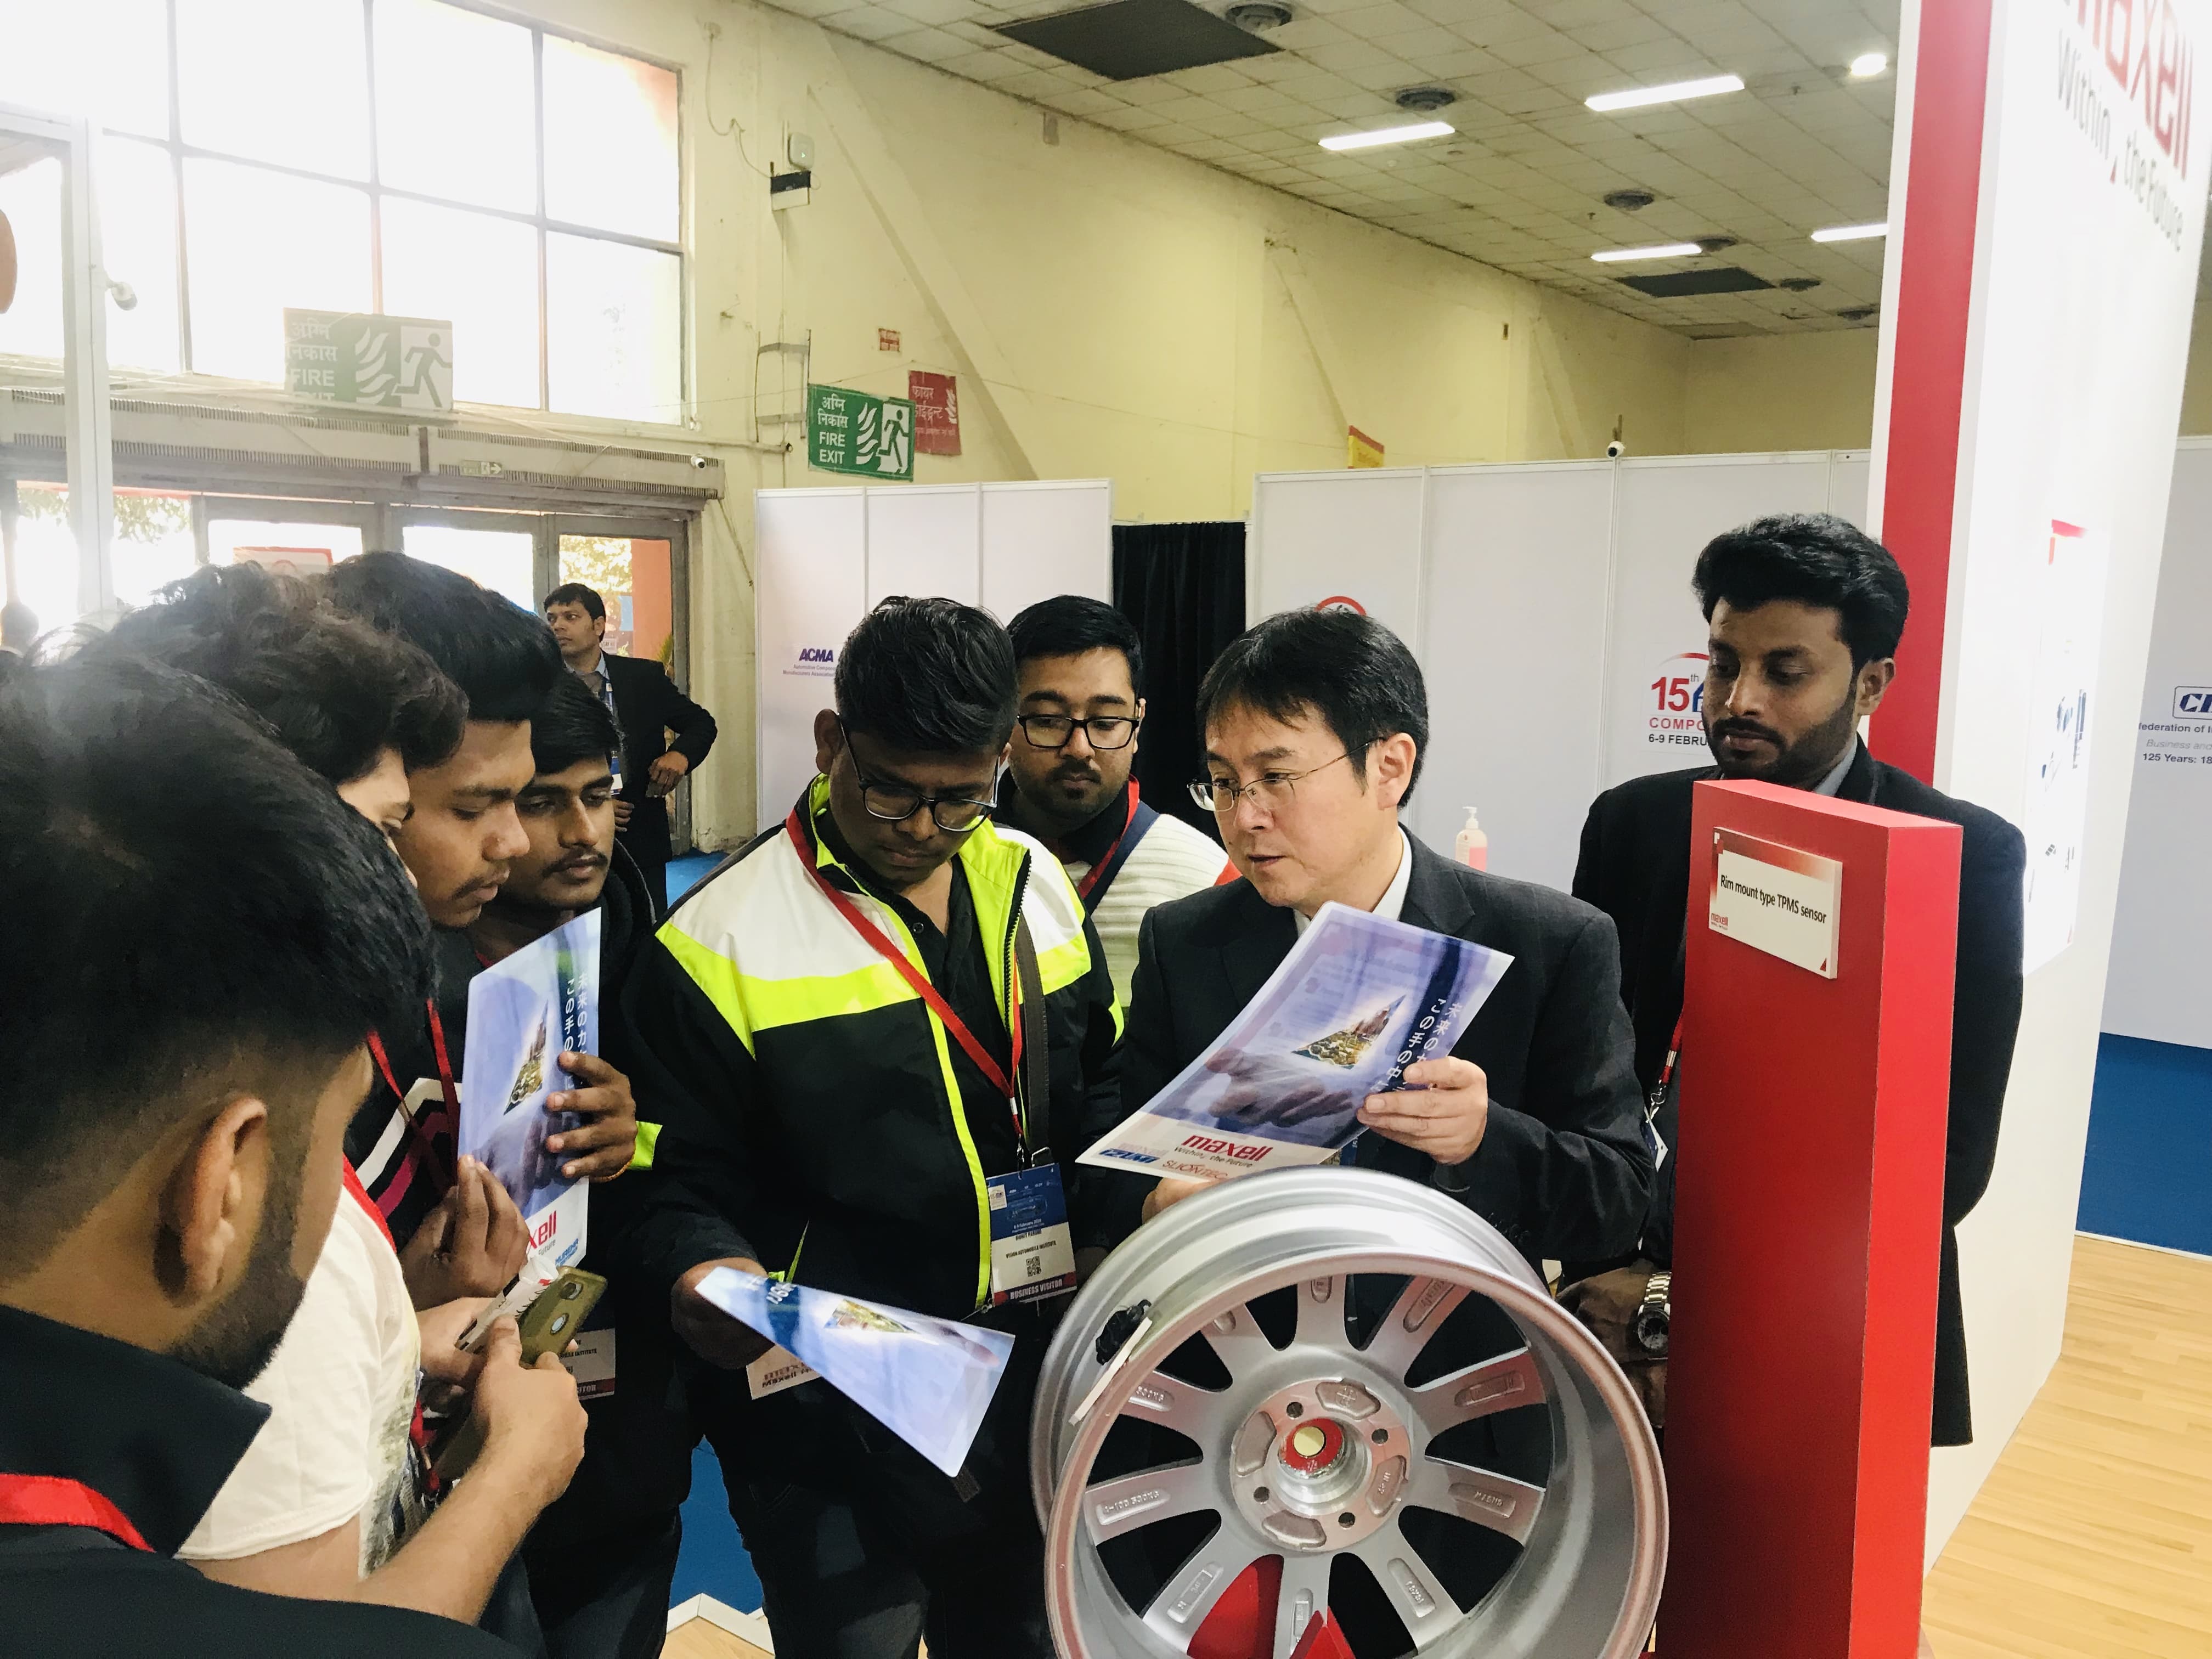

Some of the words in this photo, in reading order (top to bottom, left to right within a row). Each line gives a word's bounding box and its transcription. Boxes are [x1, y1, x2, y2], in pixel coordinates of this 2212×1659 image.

[290, 368, 335, 387] FIRE
[821, 393, 846, 411] अग्नि
[817, 408, 849, 428] निकास
[819, 431, 846, 447] FIRE
[820, 449, 845, 464] EXIT
[799, 648, 834, 663] ACMA
[1649, 717, 1705, 731] COMPO
[2194, 725, 2205, 733] of
[1649, 733, 1665, 743] 6-9
[1668, 735, 1708, 746] FEBRU
[2146, 739, 2191, 749] Business
[2142, 753, 2161, 761] 125
[2164, 754, 2197, 763] Years:
[2200, 756, 2212, 764] 18
[1720, 874, 1734, 890] Rim
[1735, 882, 1759, 900] mount
[1759, 889, 1776, 907] type
[1777, 894, 1799, 915] TPMS
[1801, 905, 1827, 924] sensor
[1711, 912, 1728, 926] maxell
[1181, 1135, 1273, 1161] maxell
[1209, 1154, 1226, 1163] the
[1227, 1157, 1253, 1168] Future
[527, 1210, 557, 1252] xell
[1010, 1285, 1039, 1300] BUSINESS
[1040, 1278, 1063, 1294] VISITOR
